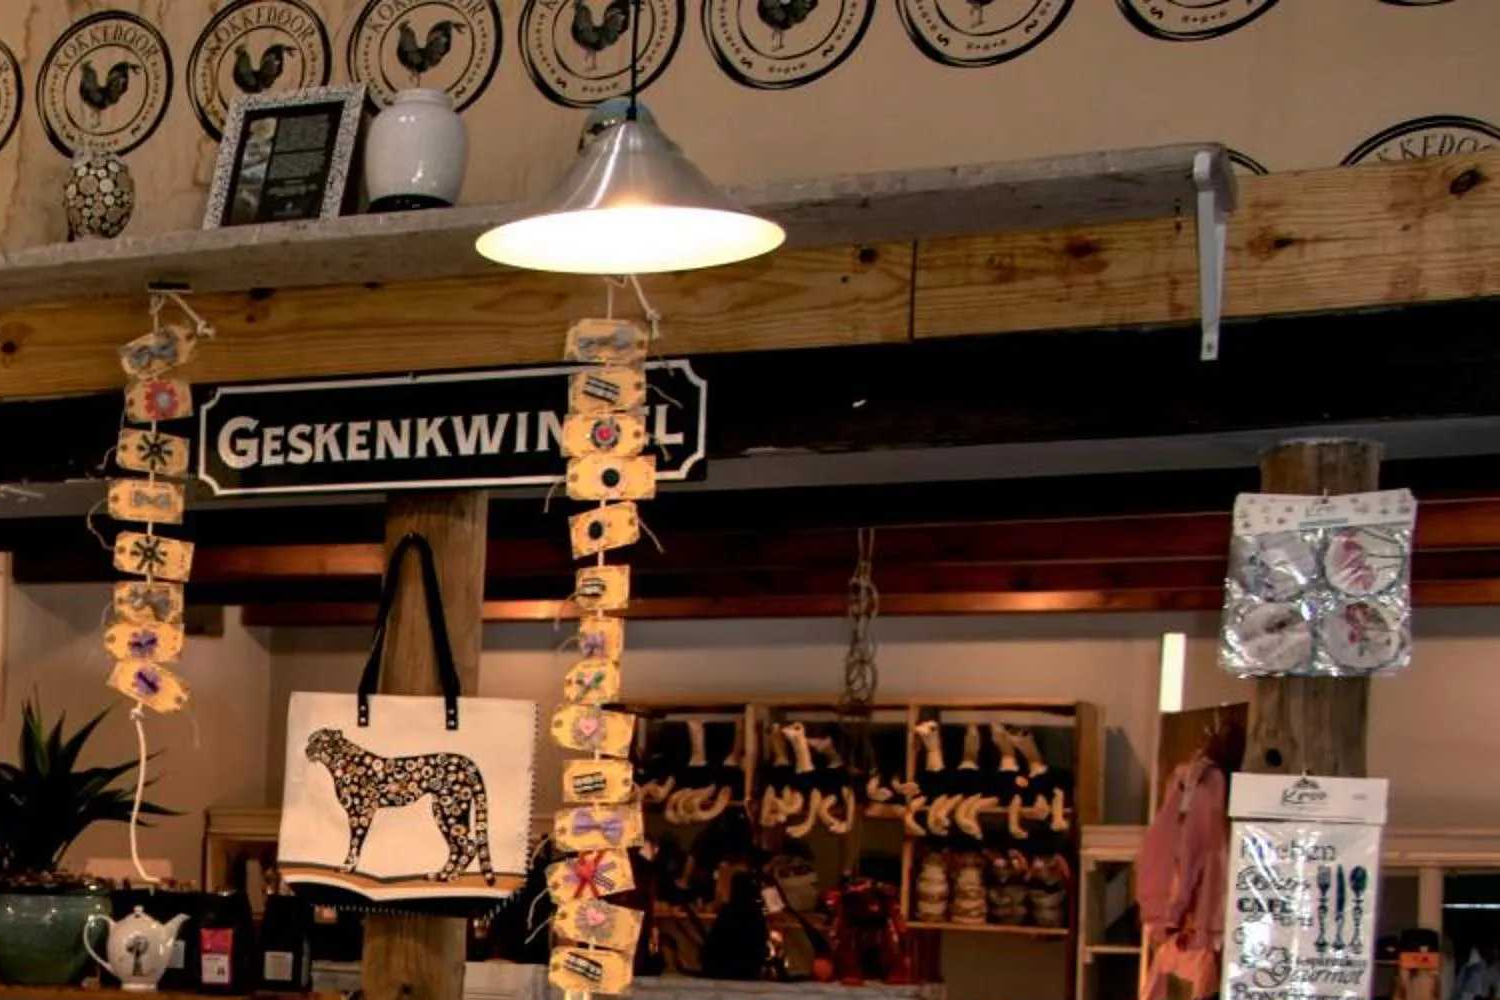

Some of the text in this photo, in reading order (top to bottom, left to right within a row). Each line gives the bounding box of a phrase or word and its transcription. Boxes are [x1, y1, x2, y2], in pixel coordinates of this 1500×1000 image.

[54, 23, 158, 72] KOKKEDOOR
[206, 6, 316, 53] KOKKEDOOR
[218, 403, 684, 470] GESKENKWINL
